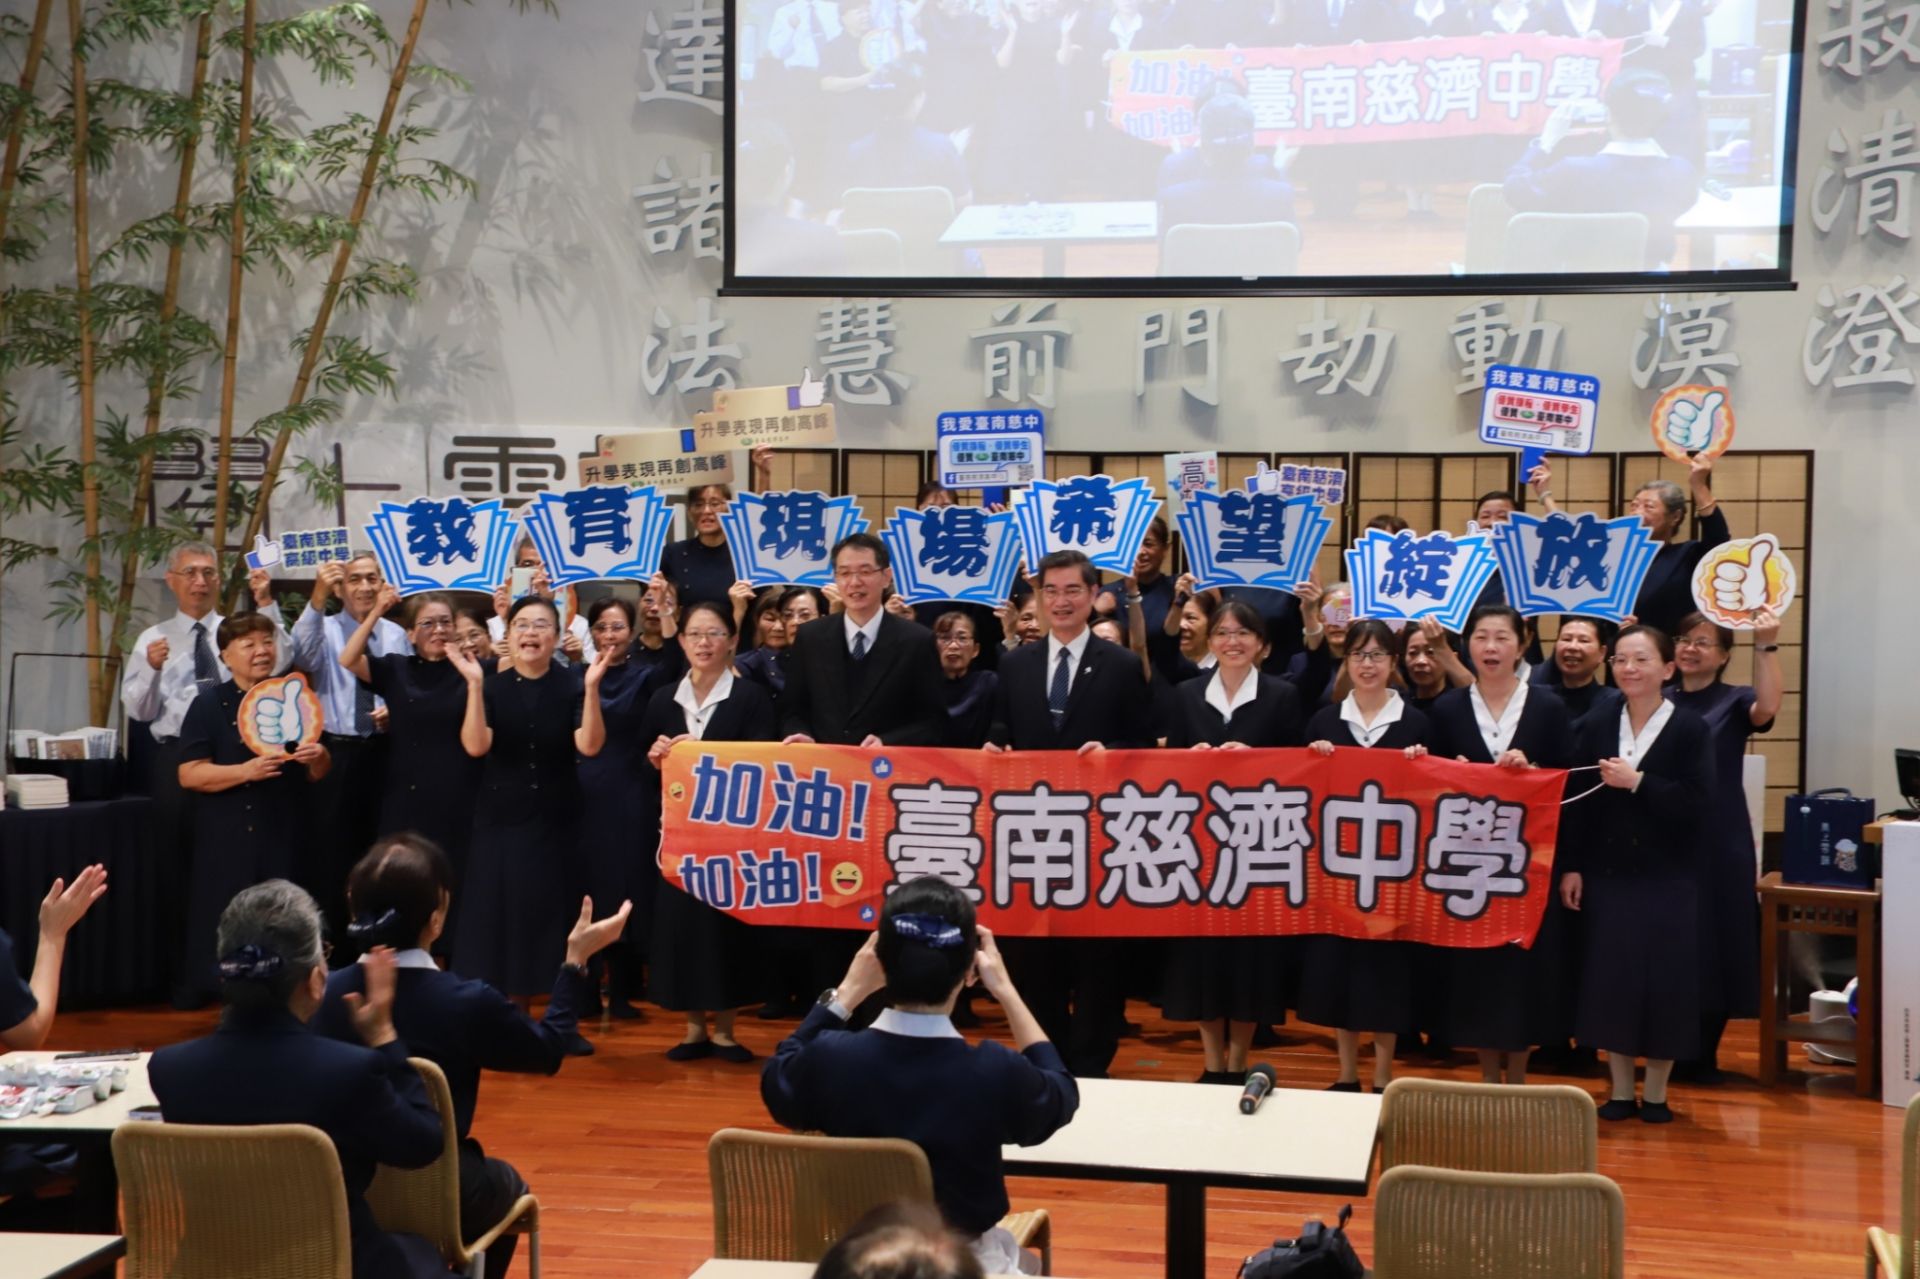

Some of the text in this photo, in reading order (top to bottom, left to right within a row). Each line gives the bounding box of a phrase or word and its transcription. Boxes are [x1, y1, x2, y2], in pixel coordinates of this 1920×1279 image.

[1128, 51, 1602, 130] 加油 臺南慈濟中學
[1491, 369, 1595, 396] 我愛臺南慈中
[700, 413, 829, 439] 升學表現再創高峰
[942, 414, 1039, 432] 我愛臺南慈中
[585, 454, 727, 483] 升學表現再創高峰
[282, 529, 347, 550] 臺南慈濟
[406, 497, 480, 566] 教
[563, 485, 632, 556] 育
[759, 490, 828, 562] 現
[919, 506, 990, 578] 場
[1050, 474, 1119, 545] 希
[1215, 489, 1288, 566] 望
[284, 547, 349, 568] 高級中學
[1379, 531, 1459, 602] 綻
[1530, 511, 1610, 591] 放
[688, 754, 871, 842] 加油!
[678, 848, 823, 910] 加油!
[885, 778, 1530, 921] 臺南慈濟中學
